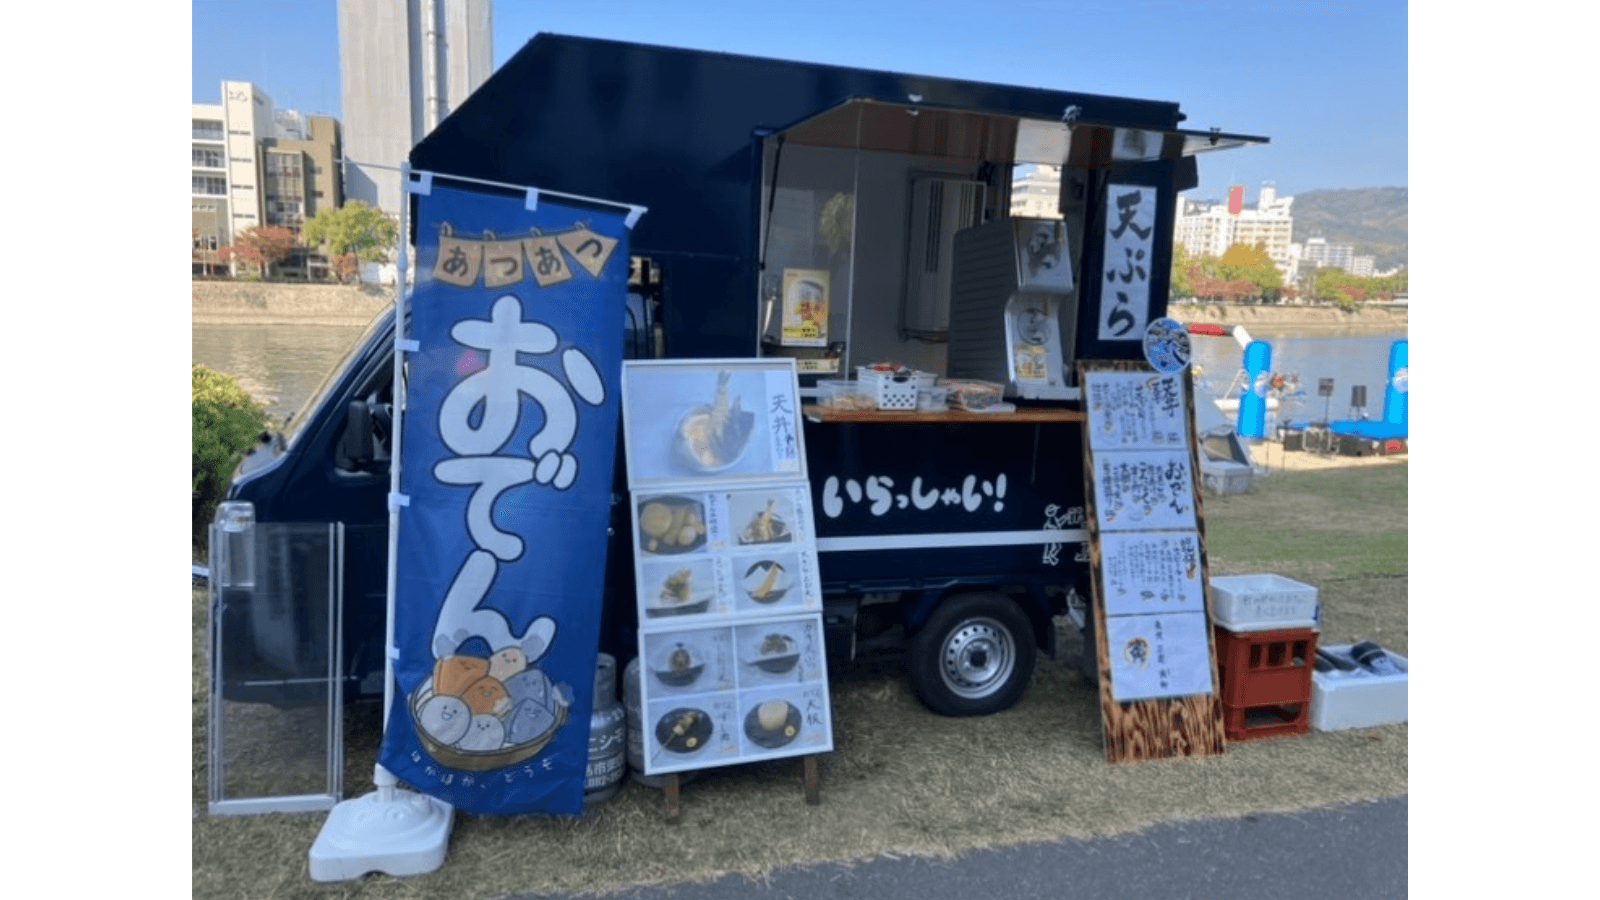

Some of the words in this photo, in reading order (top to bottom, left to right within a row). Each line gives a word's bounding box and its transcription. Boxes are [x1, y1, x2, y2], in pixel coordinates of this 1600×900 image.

[442, 237, 603, 277] あつあつ
[1106, 189, 1152, 337] 天ぷら
[432, 295, 605, 662] おでん
